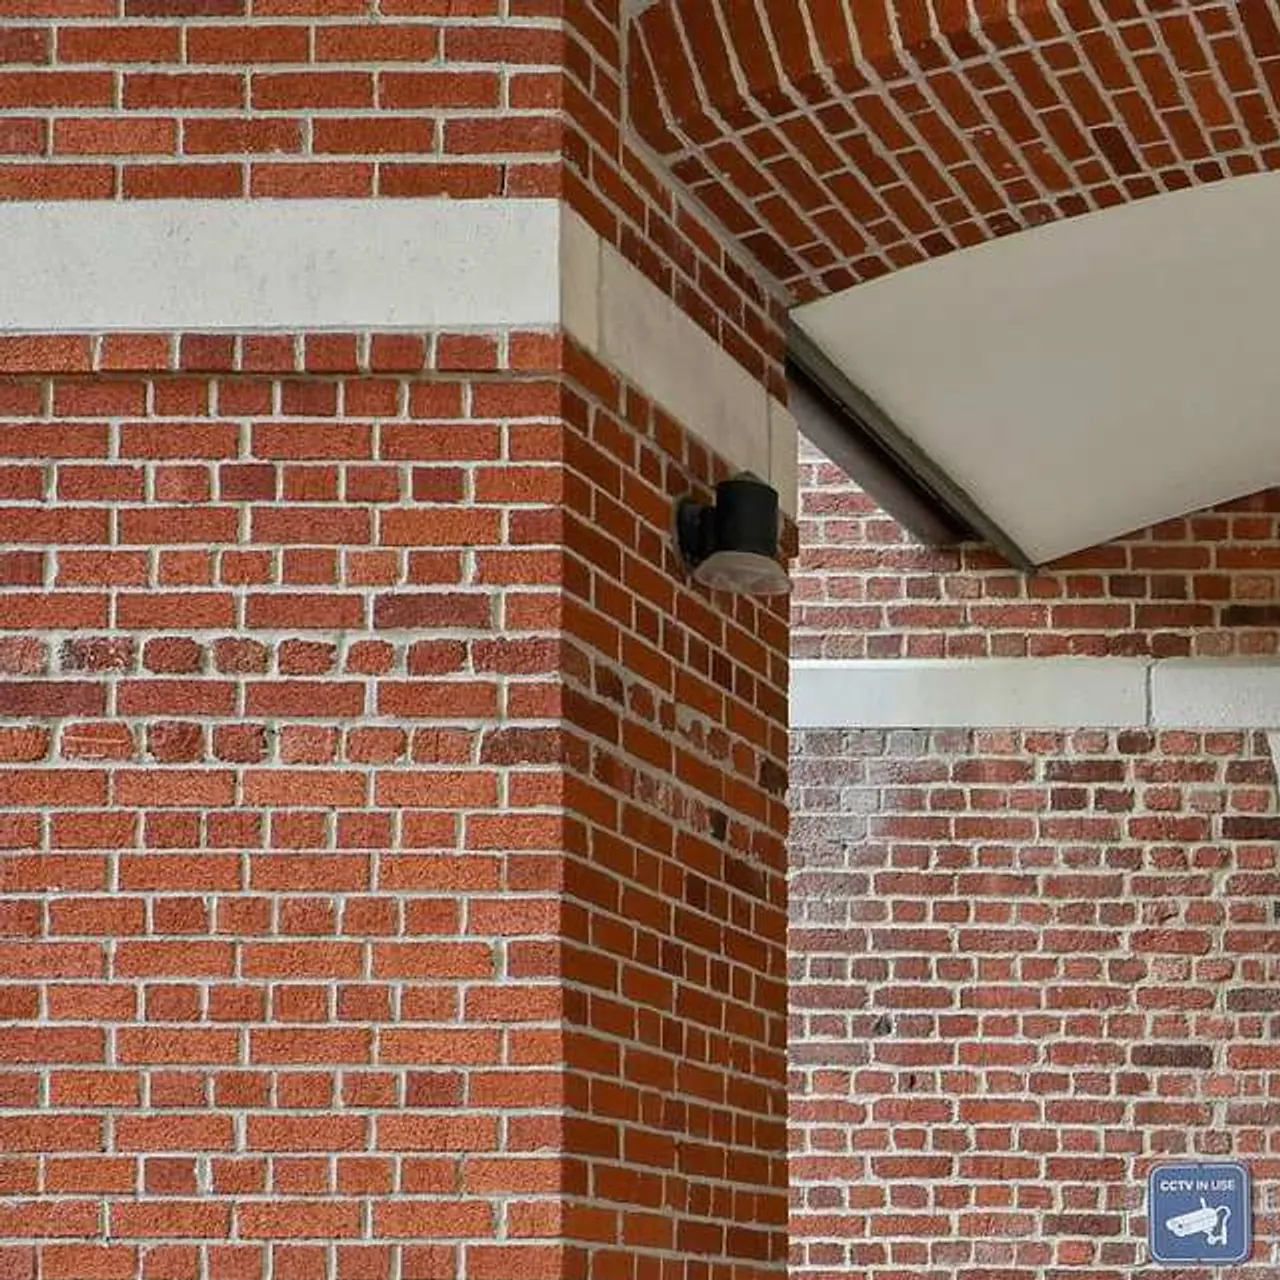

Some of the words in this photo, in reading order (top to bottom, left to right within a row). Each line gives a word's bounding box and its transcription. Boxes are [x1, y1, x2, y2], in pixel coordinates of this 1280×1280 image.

[1160, 1180, 1193, 1191] CCTV
[1196, 1180, 1209, 1191] IN
[1210, 1180, 1235, 1191] USE
